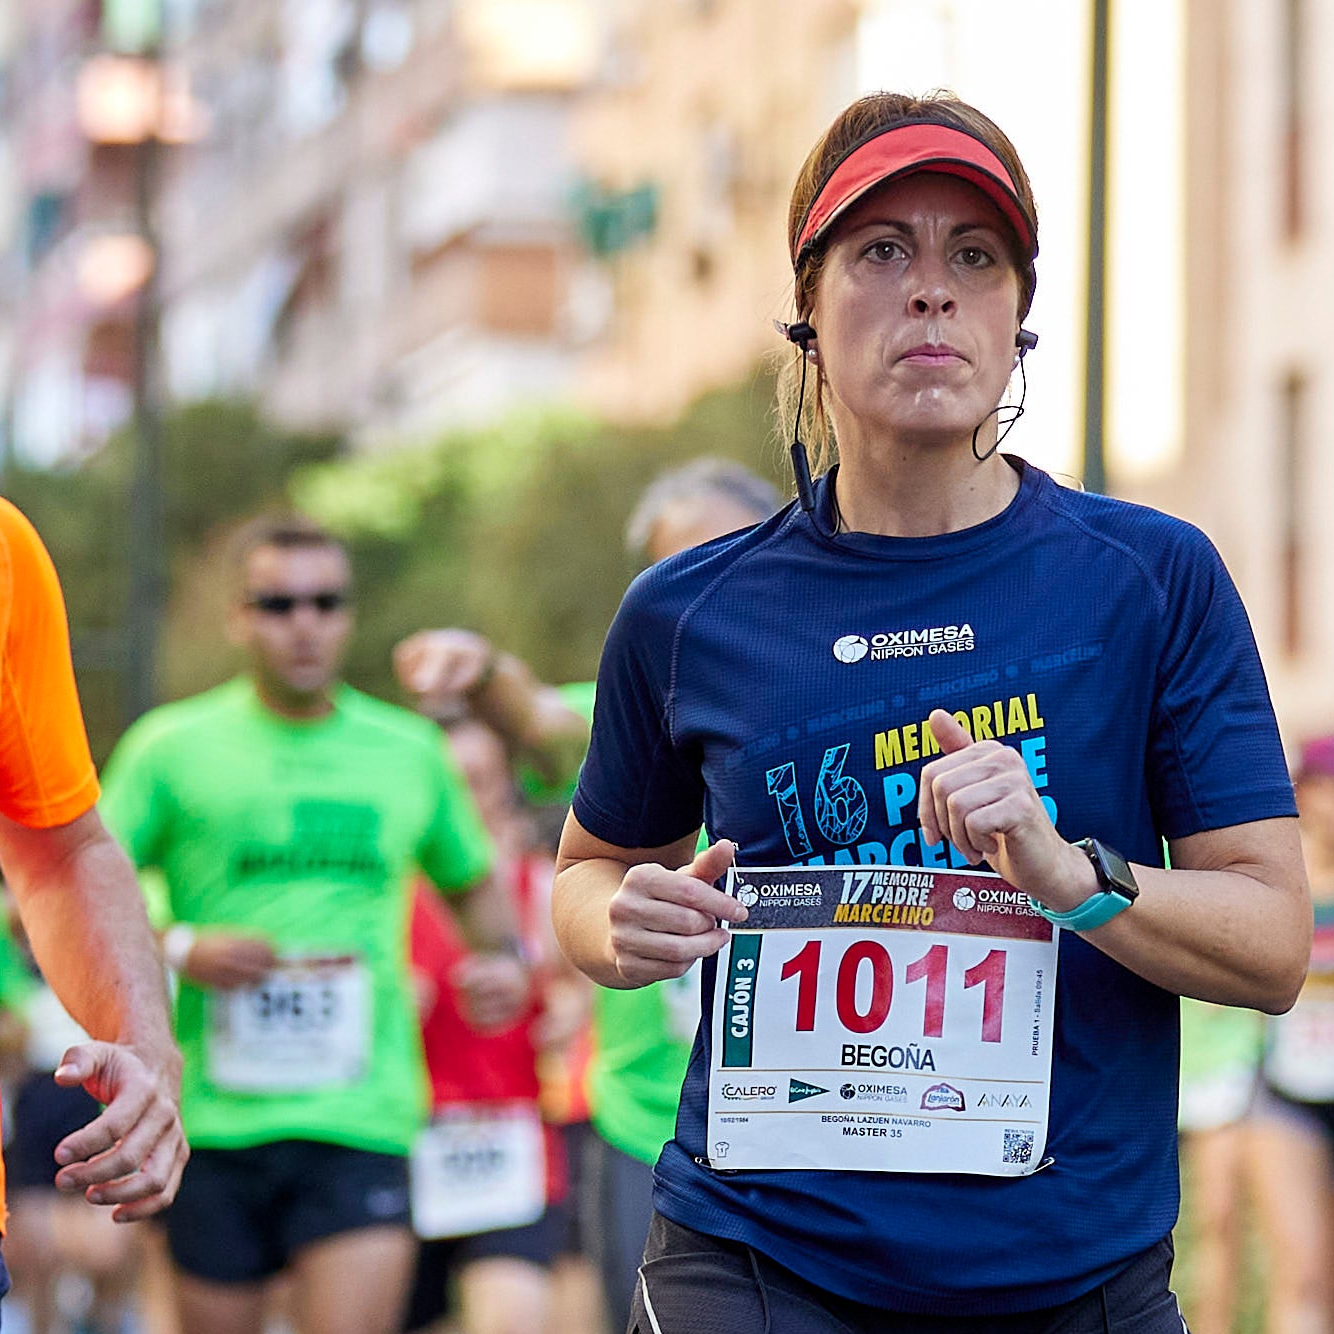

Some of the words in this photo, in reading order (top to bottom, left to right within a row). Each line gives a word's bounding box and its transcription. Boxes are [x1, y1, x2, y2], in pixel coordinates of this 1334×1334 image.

[870, 623, 975, 647] OXIMESA
[870, 645, 924, 661] NIPPON
[928, 639, 975, 655] GASES
[765, 742, 868, 858] 16
[760, 883, 823, 897] OXIMESA
[838, 871, 874, 905] 17
[871, 871, 935, 889] MEMORIAL
[759, 899, 791, 908] NIPPON
[793, 897, 823, 907] GASES
[870, 885, 930, 907] PADRE
[832, 904, 935, 927] MARCELINO
[977, 904, 1013, 915] NIPPON
[736, 957, 755, 971] 3
[780, 940, 1008, 1044] 1011
[728, 977, 753, 1039] CAJÓN
[1031, 1025, 1040, 1056] PRUEBA
[840, 1043, 937, 1072] BEGOÑA
[724, 1086, 776, 1096] CALERO
[857, 1084, 908, 1095] OXIMESA
[977, 1093, 1033, 1108] ANAYA
[821, 1114, 855, 1123] BEGOÑA
[857, 1116, 890, 1124] LAZUEN
[891, 1118, 932, 1128] NAVARRO
[842, 1127, 887, 1137] MASTER
[889, 1129, 903, 1138] 35
